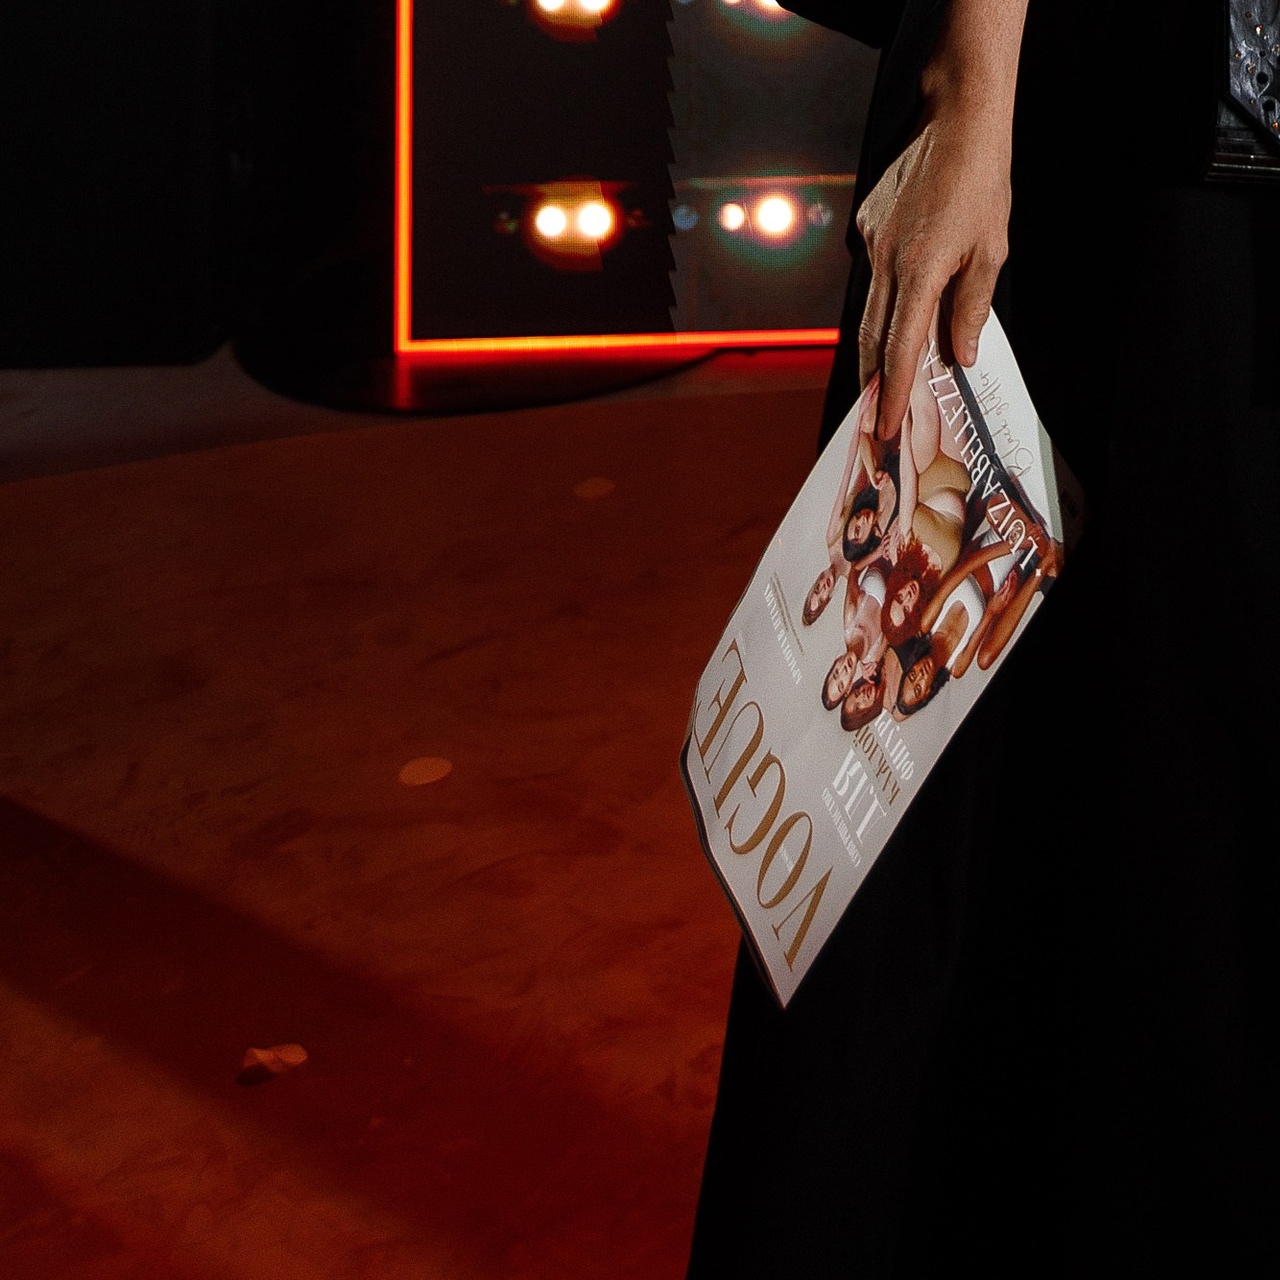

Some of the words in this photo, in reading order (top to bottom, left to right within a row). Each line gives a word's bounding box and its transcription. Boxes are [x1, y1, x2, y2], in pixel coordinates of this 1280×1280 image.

[921, 340, 1039, 569] LUIZABELLEZZA
[694, 638, 834, 970] VOGUE
[830, 747, 887, 844] ДЛЯ
